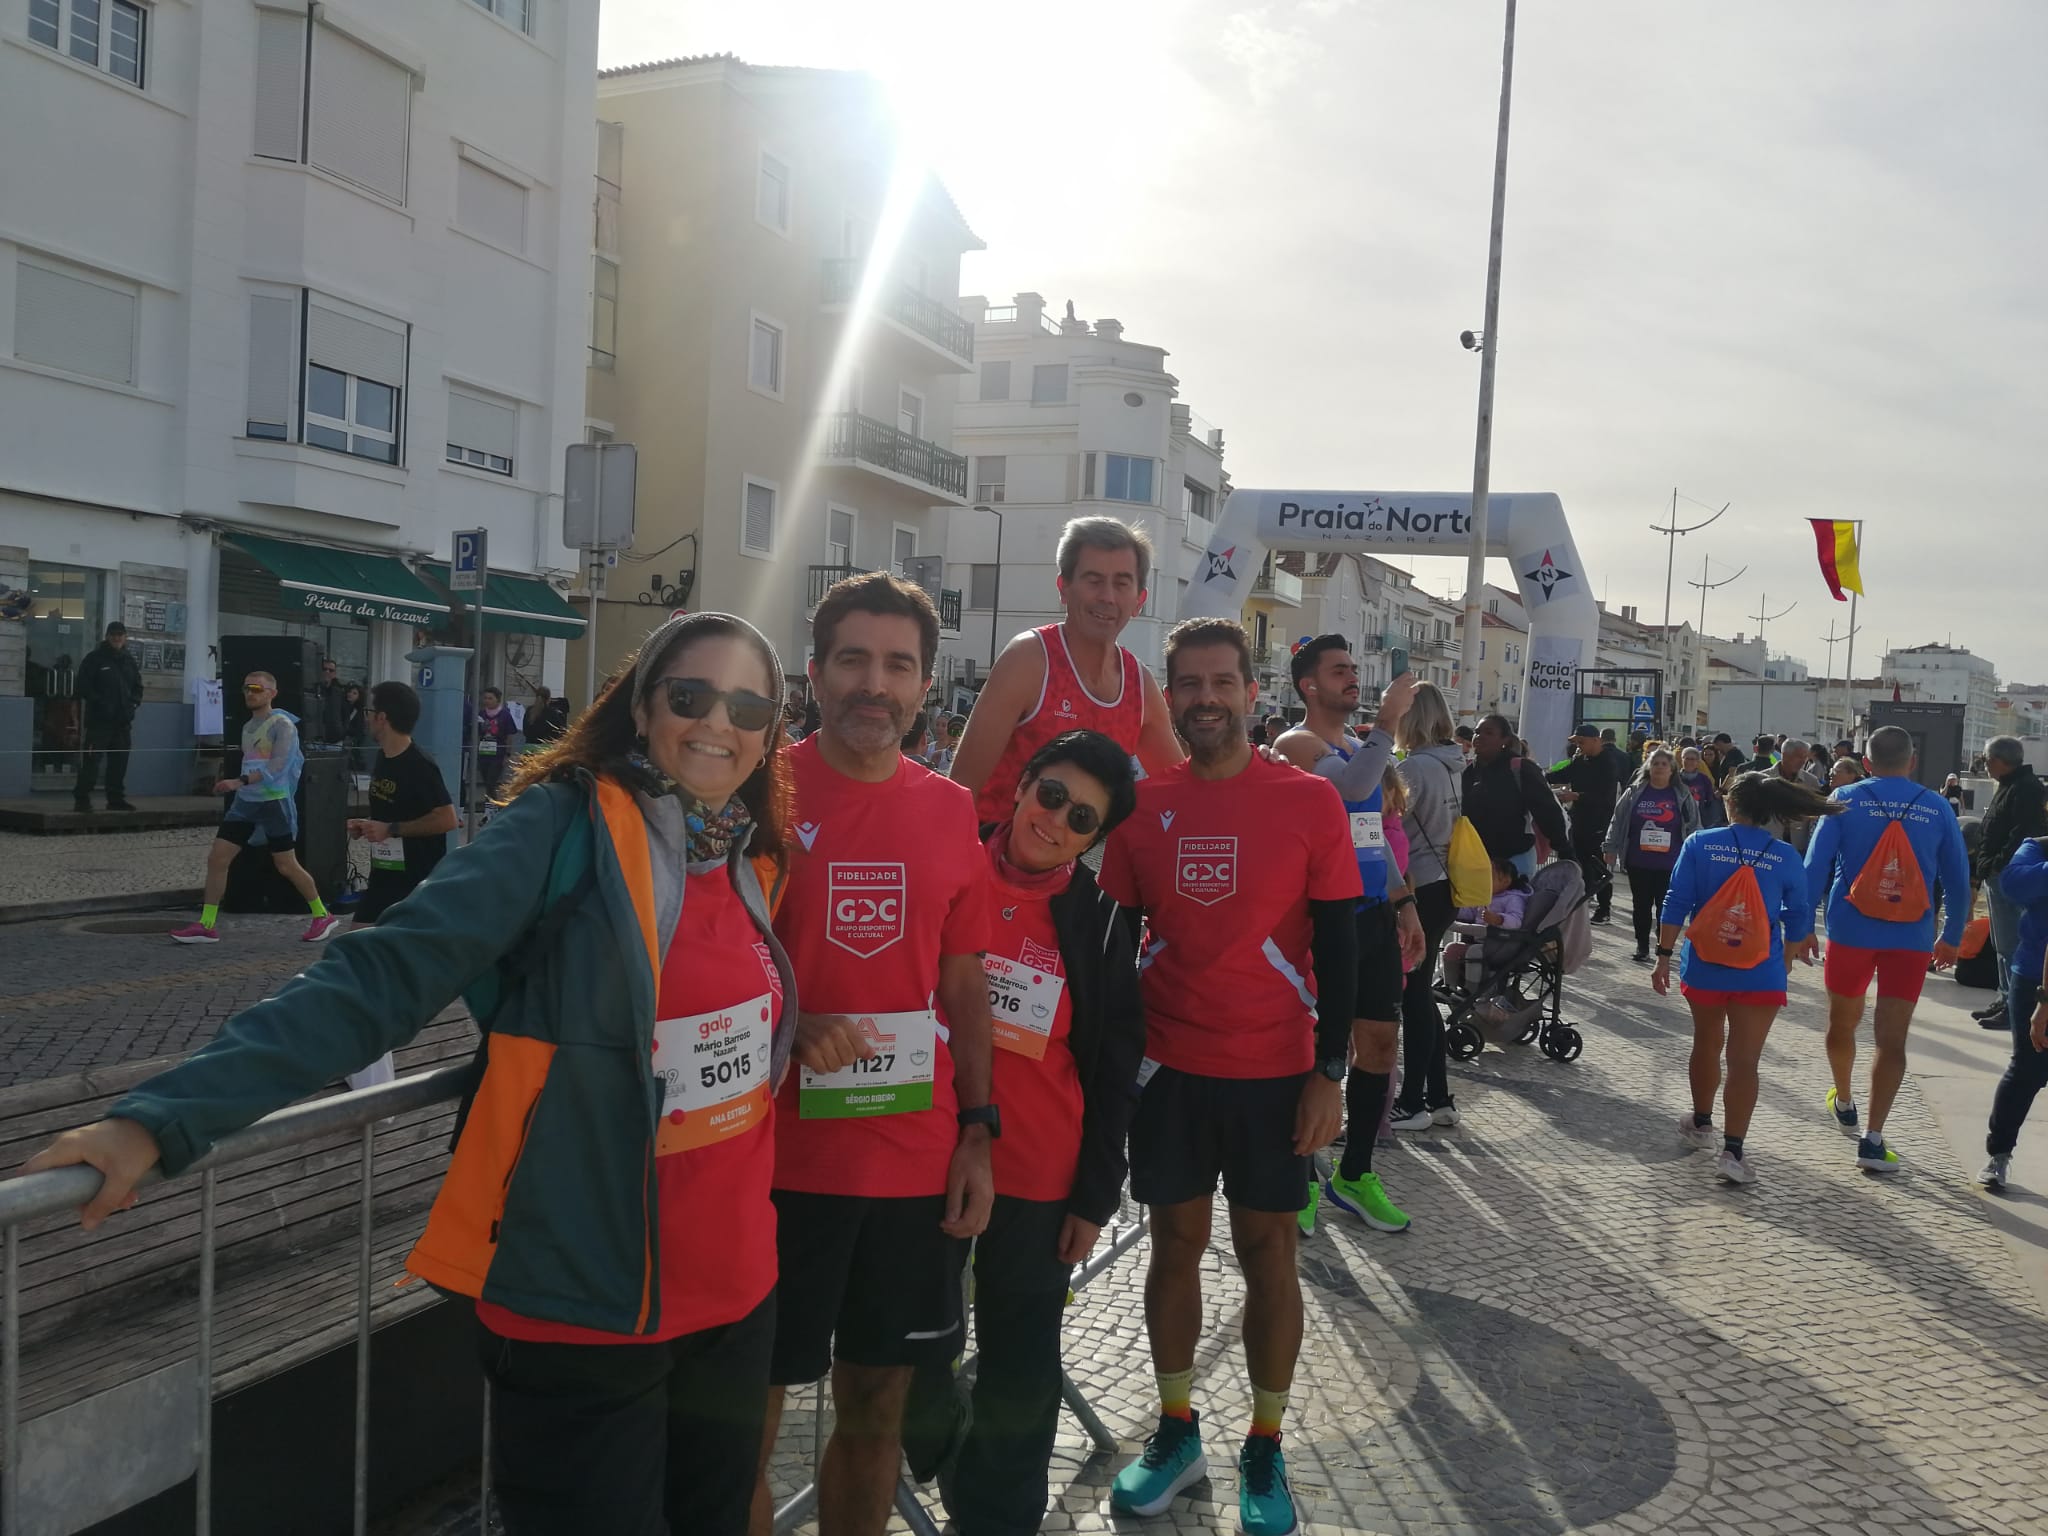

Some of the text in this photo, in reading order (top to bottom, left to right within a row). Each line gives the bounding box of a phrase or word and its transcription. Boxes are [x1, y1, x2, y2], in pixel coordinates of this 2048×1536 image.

[1279, 502, 1365, 531] Praia
[1368, 520, 1383, 531] do
[458, 536, 473, 569] P
[304, 593, 430, 624] Pérola da Nazaré
[423, 668, 433, 686] P
[1531, 660, 1570, 677] Praia
[1529, 675, 1571, 690] Norte
[837, 871, 897, 881] FIDELIDADE
[1182, 863, 1230, 881] GDC
[836, 898, 897, 923] GDC
[984, 959, 1013, 975] galp
[1000, 976, 1029, 991] Barroso
[698, 1013, 733, 1039] galp
[694, 1030, 751, 1054] Mário Barroso
[713, 1045, 738, 1058] Nazaré
[701, 1053, 751, 1088] 5015
[845, 1092, 896, 1105] SÉRGIO RIBEIRO
[710, 1113, 726, 1126] ANA
[726, 1103, 752, 1122] ESTRELA
